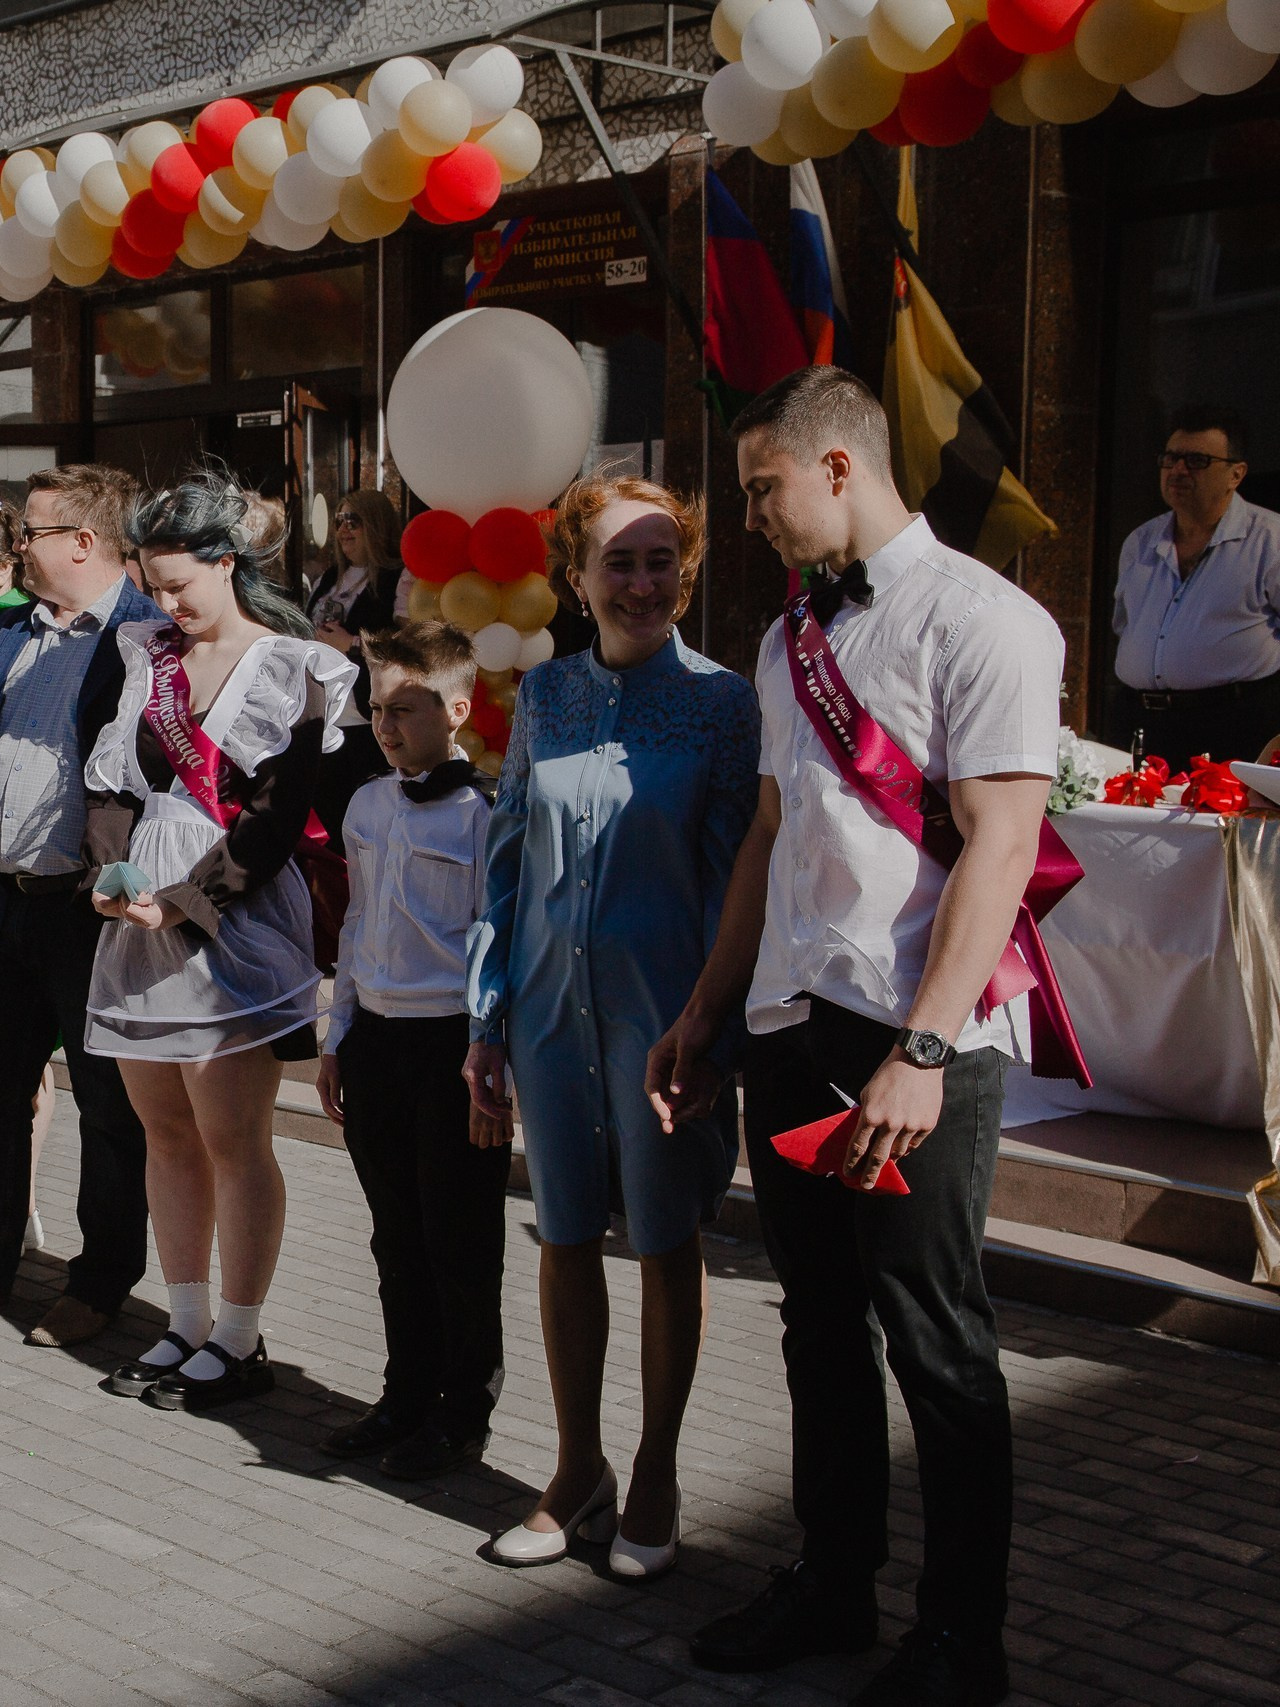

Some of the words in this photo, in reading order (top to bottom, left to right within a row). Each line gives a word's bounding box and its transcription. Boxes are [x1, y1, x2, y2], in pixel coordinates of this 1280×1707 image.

[528, 210, 621, 235] УЧАСТКОВАЯ
[513, 226, 637, 255] ИЗБИРАТЕЛЬНАЯ
[534, 246, 615, 270] КОМИССИЯ
[607, 260, 646, 281] 58-20
[813, 648, 837, 698] Пелипенко
[832, 694, 853, 723] Иван
[147, 654, 206, 771] Выпускница
